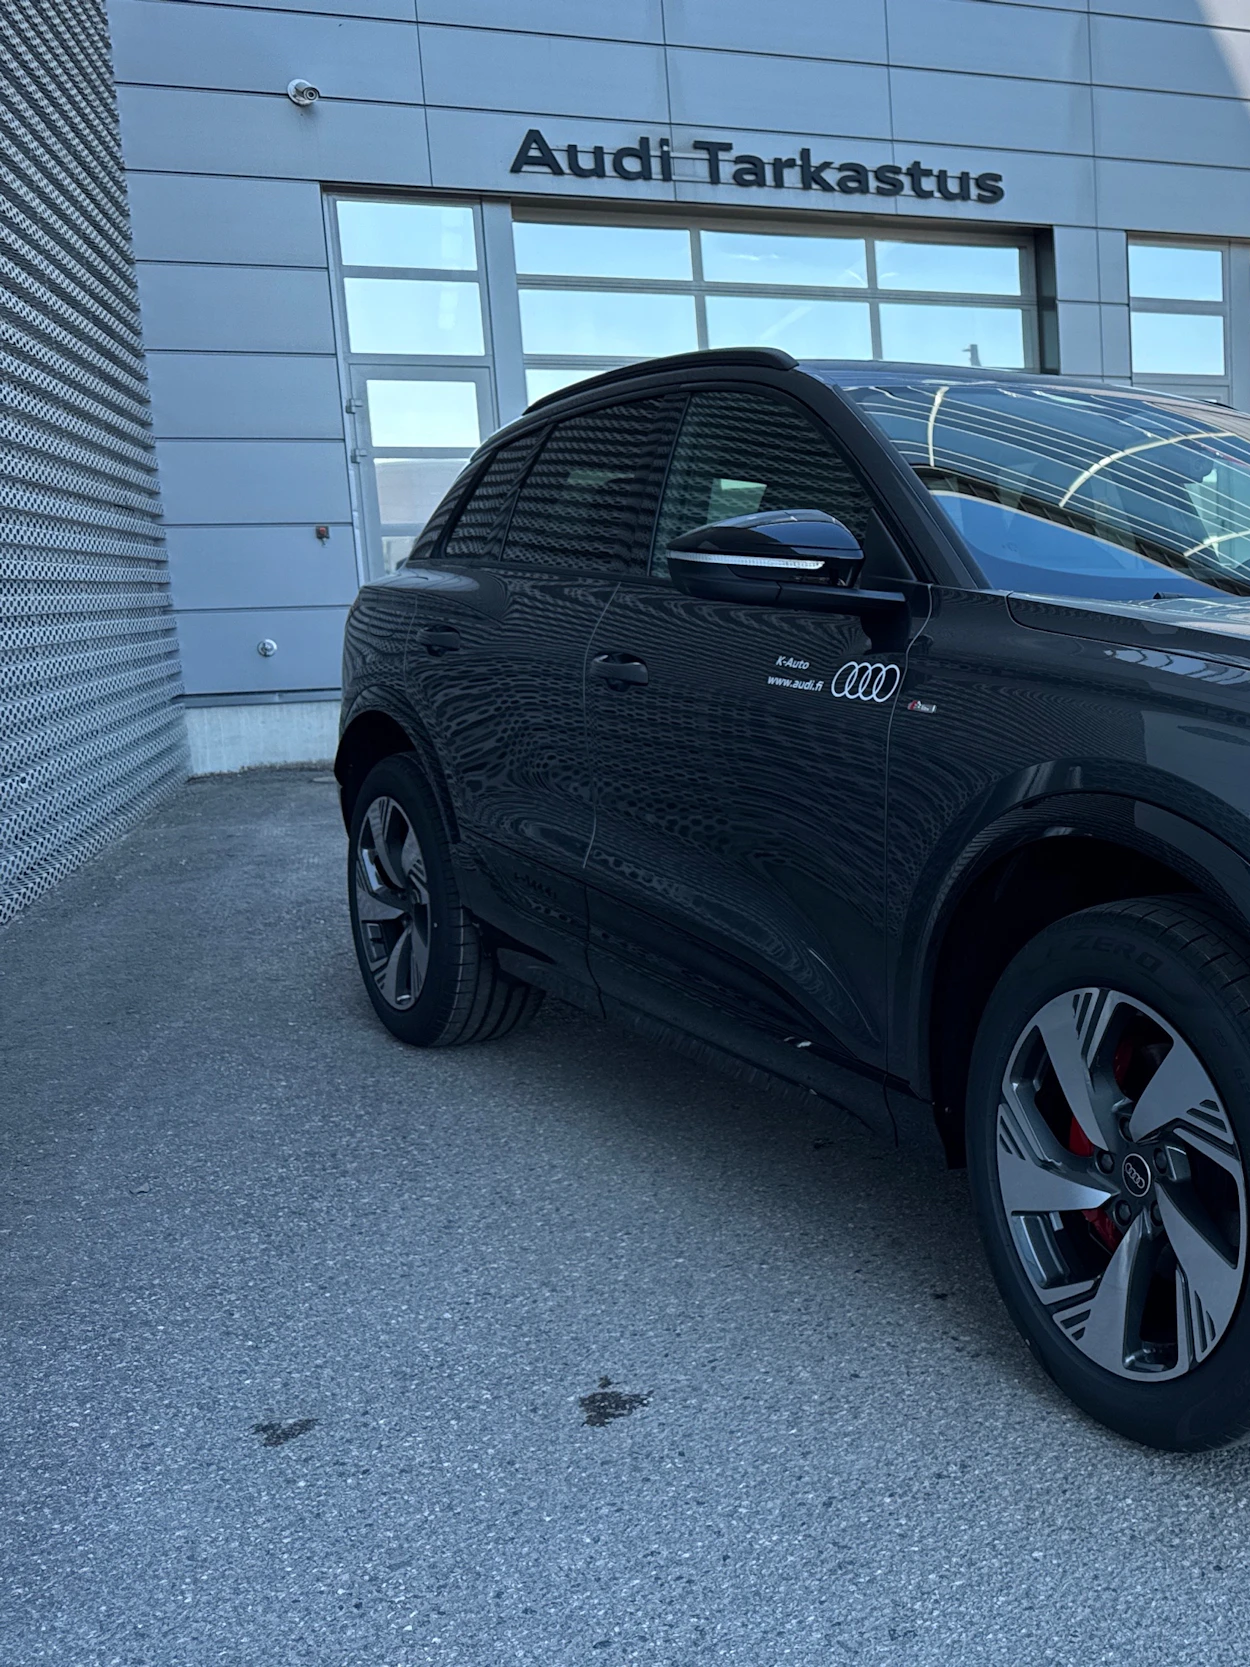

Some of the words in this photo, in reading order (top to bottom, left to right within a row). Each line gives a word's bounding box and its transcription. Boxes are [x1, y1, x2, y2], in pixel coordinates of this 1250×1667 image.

[510, 128, 674, 182] Audi
[692, 138, 1005, 205] Tarkastus
[775, 655, 810, 671] K-Auto
[767, 675, 825, 692] www.audi.fi
[1069, 933, 1164, 974] ZERO
